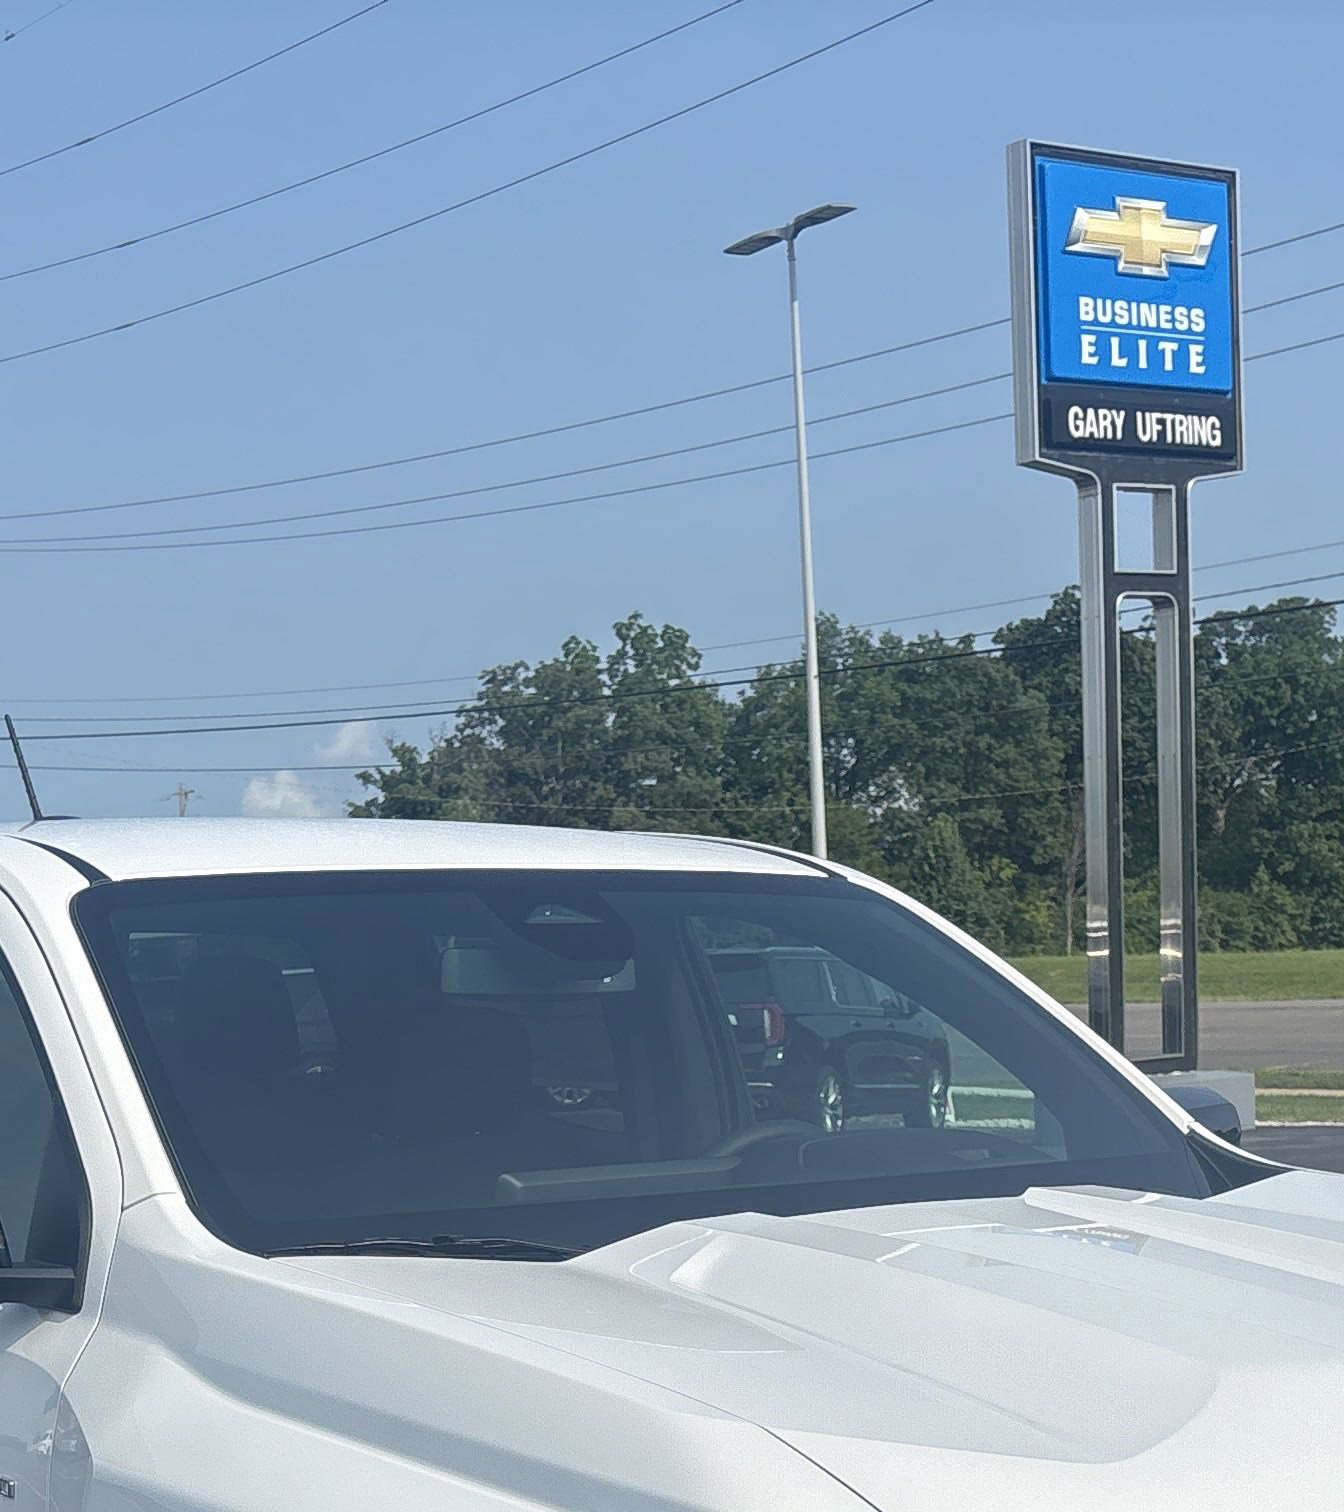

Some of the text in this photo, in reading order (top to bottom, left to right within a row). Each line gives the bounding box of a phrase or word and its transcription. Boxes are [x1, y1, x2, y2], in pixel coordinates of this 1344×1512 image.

[1078, 296, 1206, 332] BUSINESS
[1080, 334, 1207, 374] ELITE
[1068, 405, 1222, 447] GARY UFTRING
